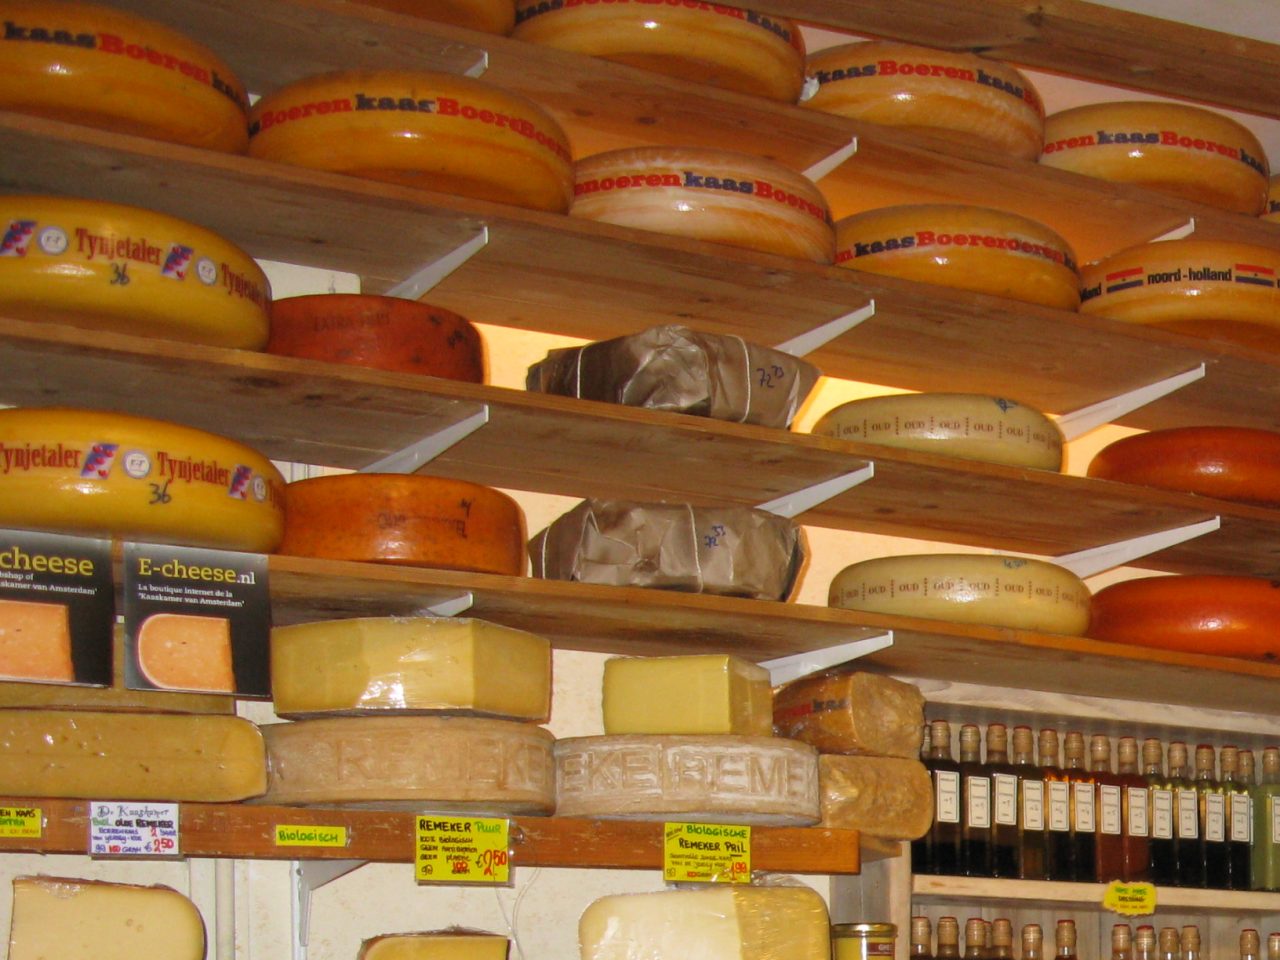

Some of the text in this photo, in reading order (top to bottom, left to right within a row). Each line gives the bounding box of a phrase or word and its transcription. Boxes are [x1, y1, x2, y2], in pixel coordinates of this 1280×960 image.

[878, 60, 976, 82] Boeren
[76, 227, 161, 265] Tynjetaler
[1147, 267, 1233, 287] noord-holland
[872, 422, 891, 431] OUD
[904, 421, 925, 431] OUD
[939, 420, 961, 431] OUD
[974, 423, 994, 433] OUD
[157, 451, 229, 486] Tynjetaler
[138, 558, 256, 585] E-cheese.nl
[138, 583, 149, 592] La
[149, 584, 184, 596] boutique
[215, 589, 224, 597] de
[226, 590, 233, 598] la
[900, 582, 919, 592] OUD
[1005, 583, 1024, 594] OUD
[185, 595, 198, 604] van
[419, 818, 472, 832] REMEKER
[679, 837, 721, 852] REMEKER
